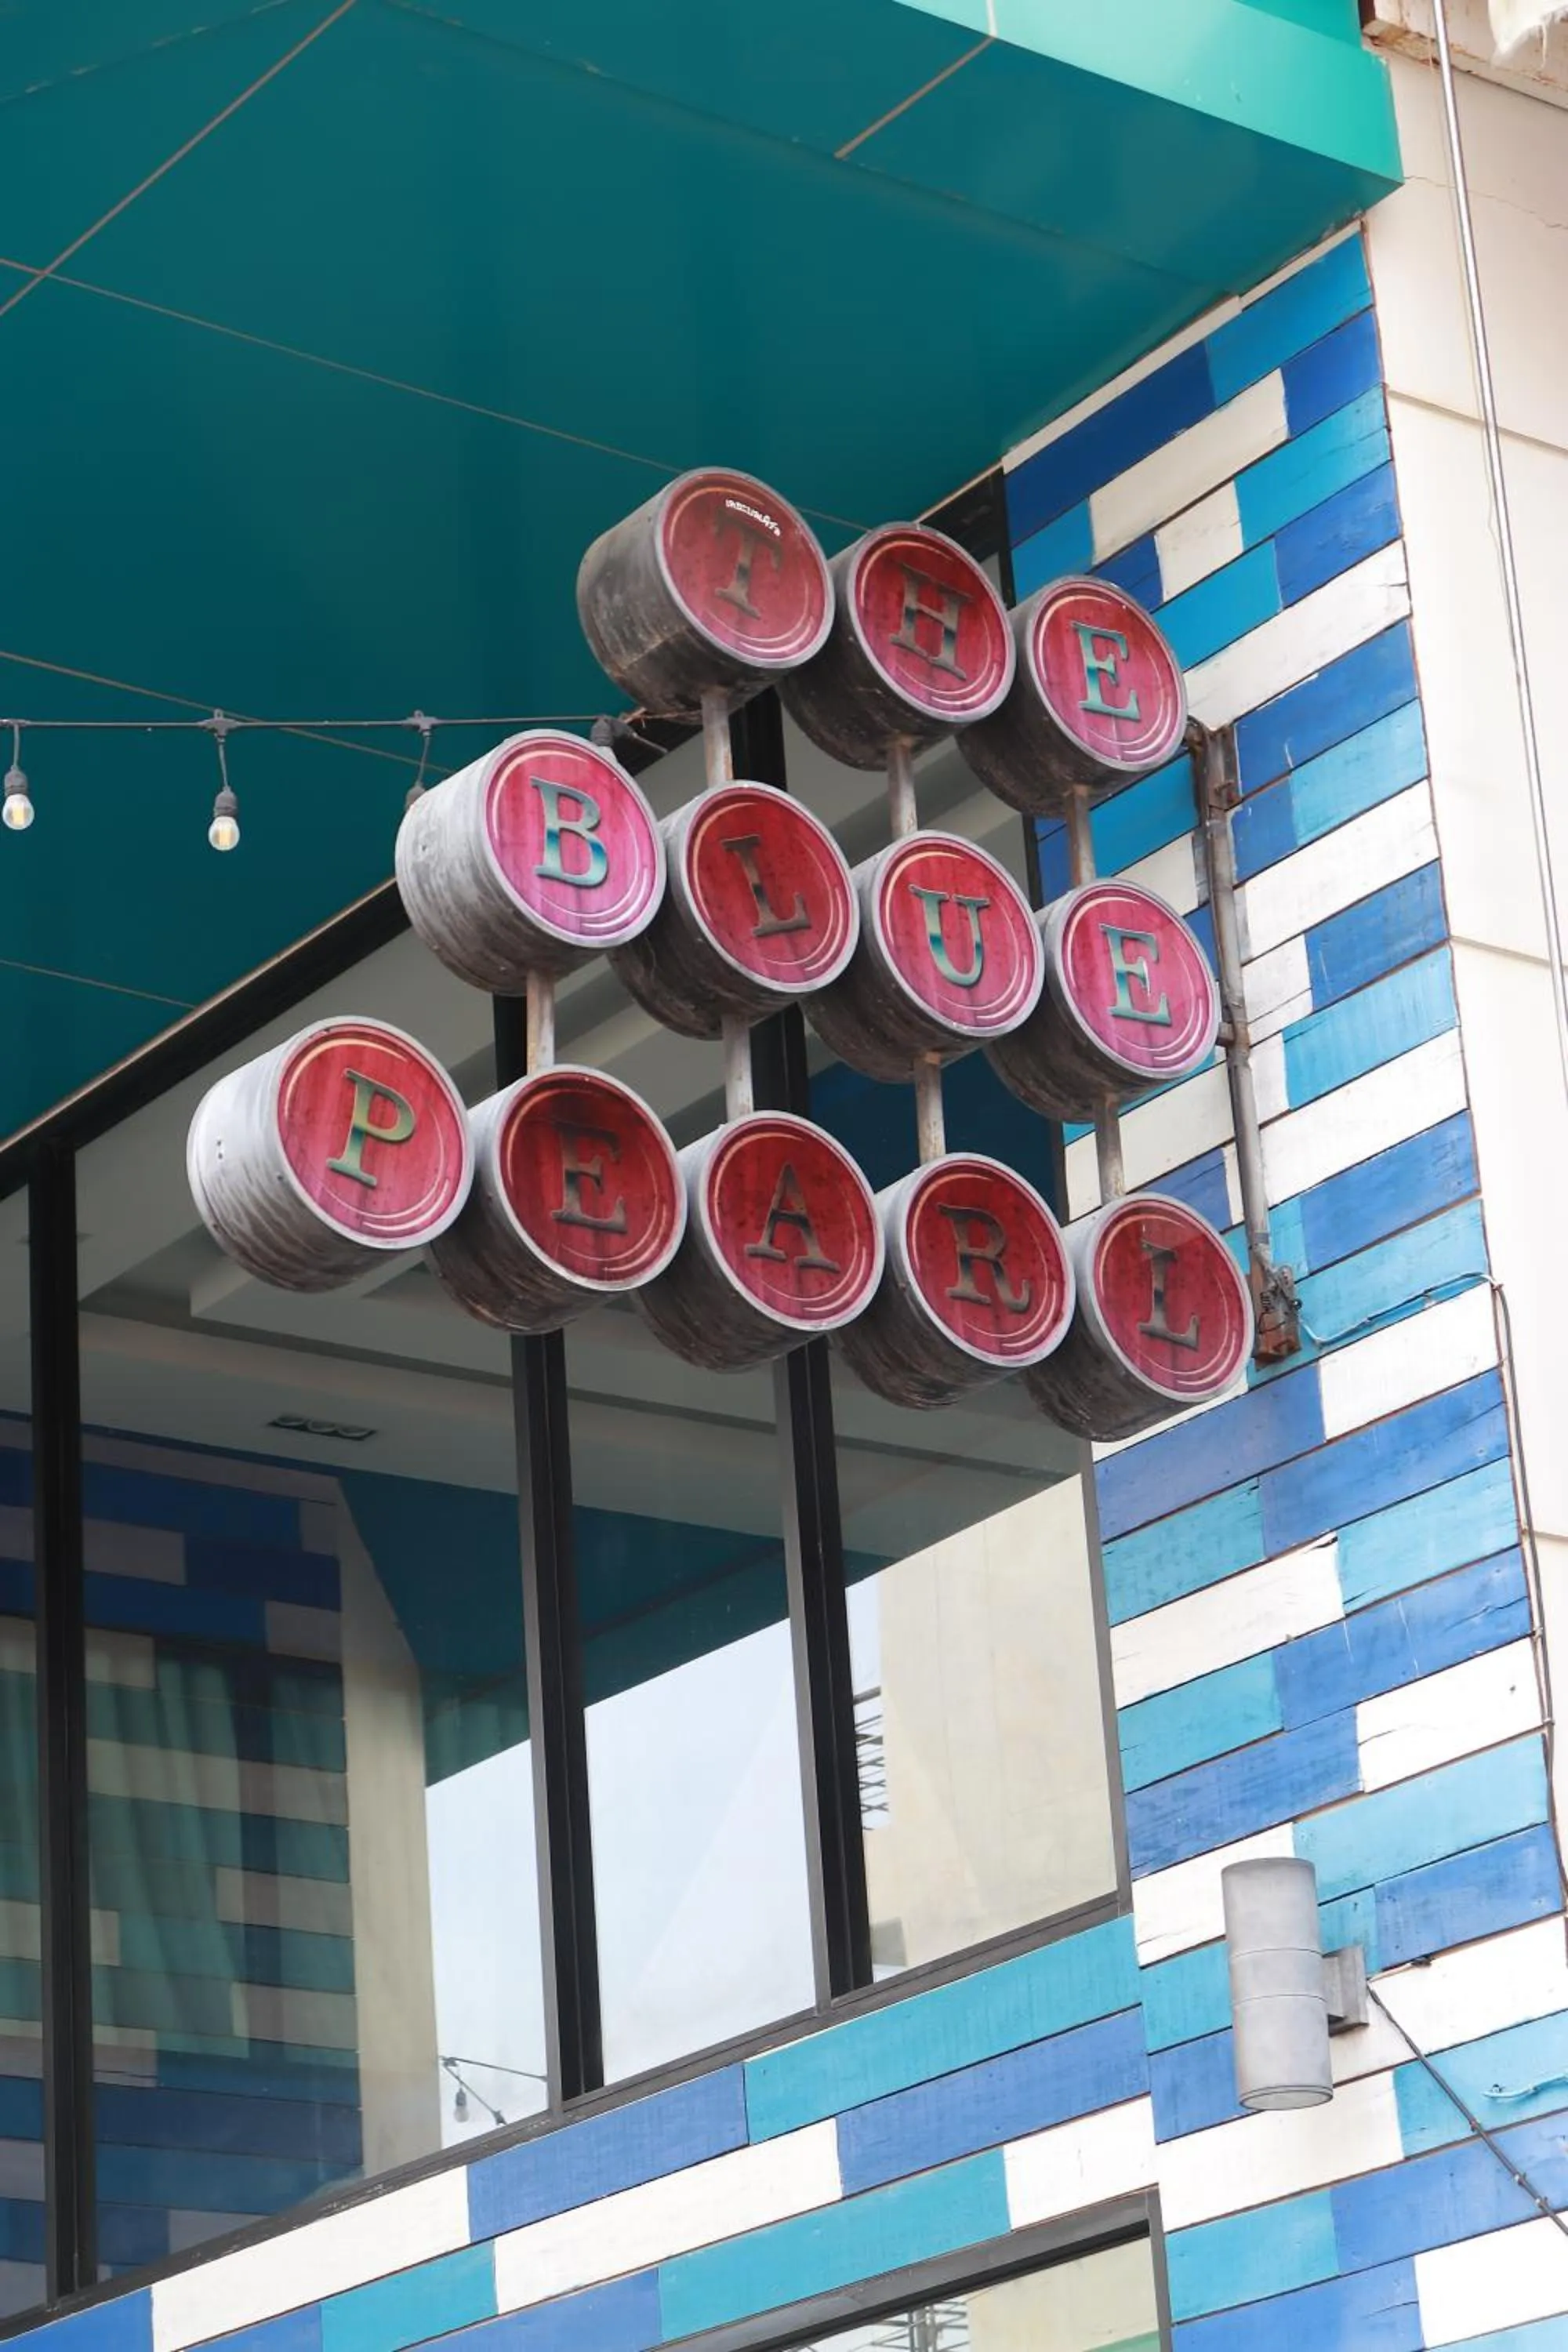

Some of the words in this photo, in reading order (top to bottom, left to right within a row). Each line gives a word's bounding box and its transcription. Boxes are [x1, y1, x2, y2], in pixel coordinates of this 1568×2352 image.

[714, 508, 1142, 721] THE
[530, 776, 1171, 1026] BLUE
[326, 1068, 1199, 1352] PEARL
